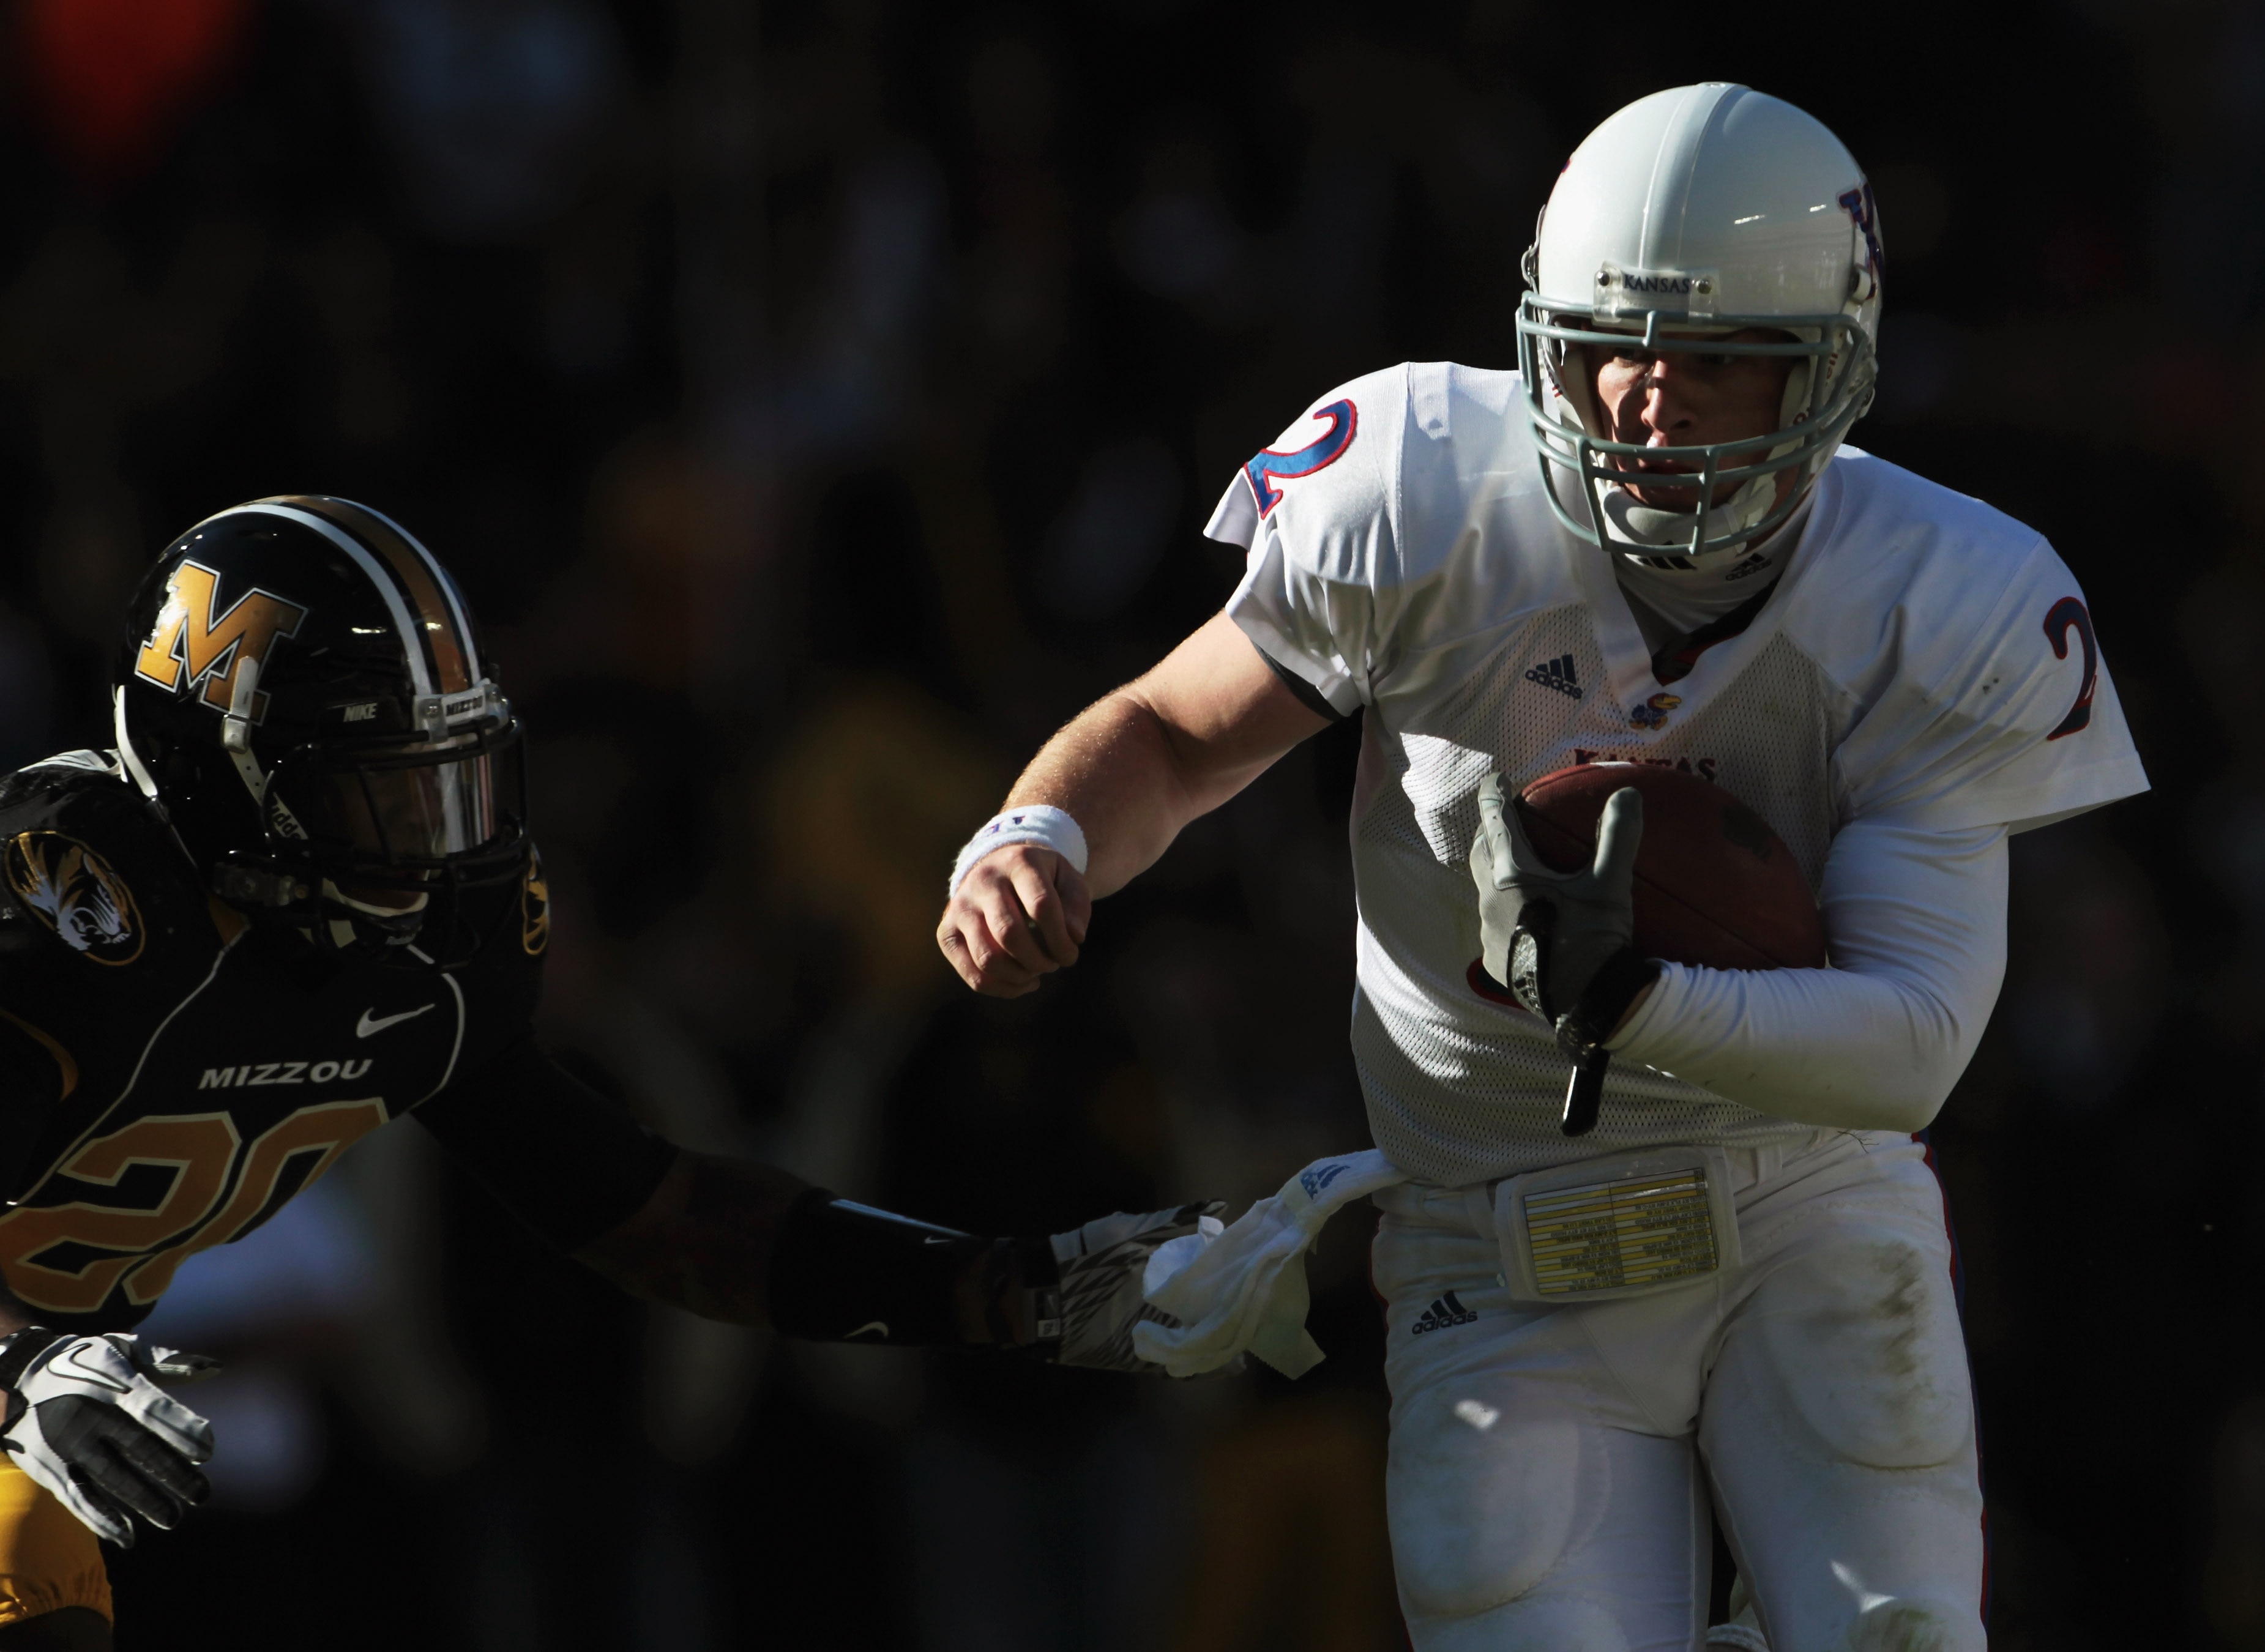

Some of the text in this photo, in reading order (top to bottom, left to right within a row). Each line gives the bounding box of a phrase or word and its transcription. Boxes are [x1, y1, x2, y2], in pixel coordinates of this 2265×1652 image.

[1623, 273, 1691, 295] KANSAS
[1244, 398, 1357, 519] 2
[134, 560, 308, 726] M
[1524, 667, 1583, 701] adidas
[2043, 596, 2098, 741] 2
[343, 702, 378, 723] NIKE
[446, 695, 484, 716] MIZZOU
[198, 1059, 373, 1090] MIZZOU
[1411, 1310, 1478, 1335] adidas
